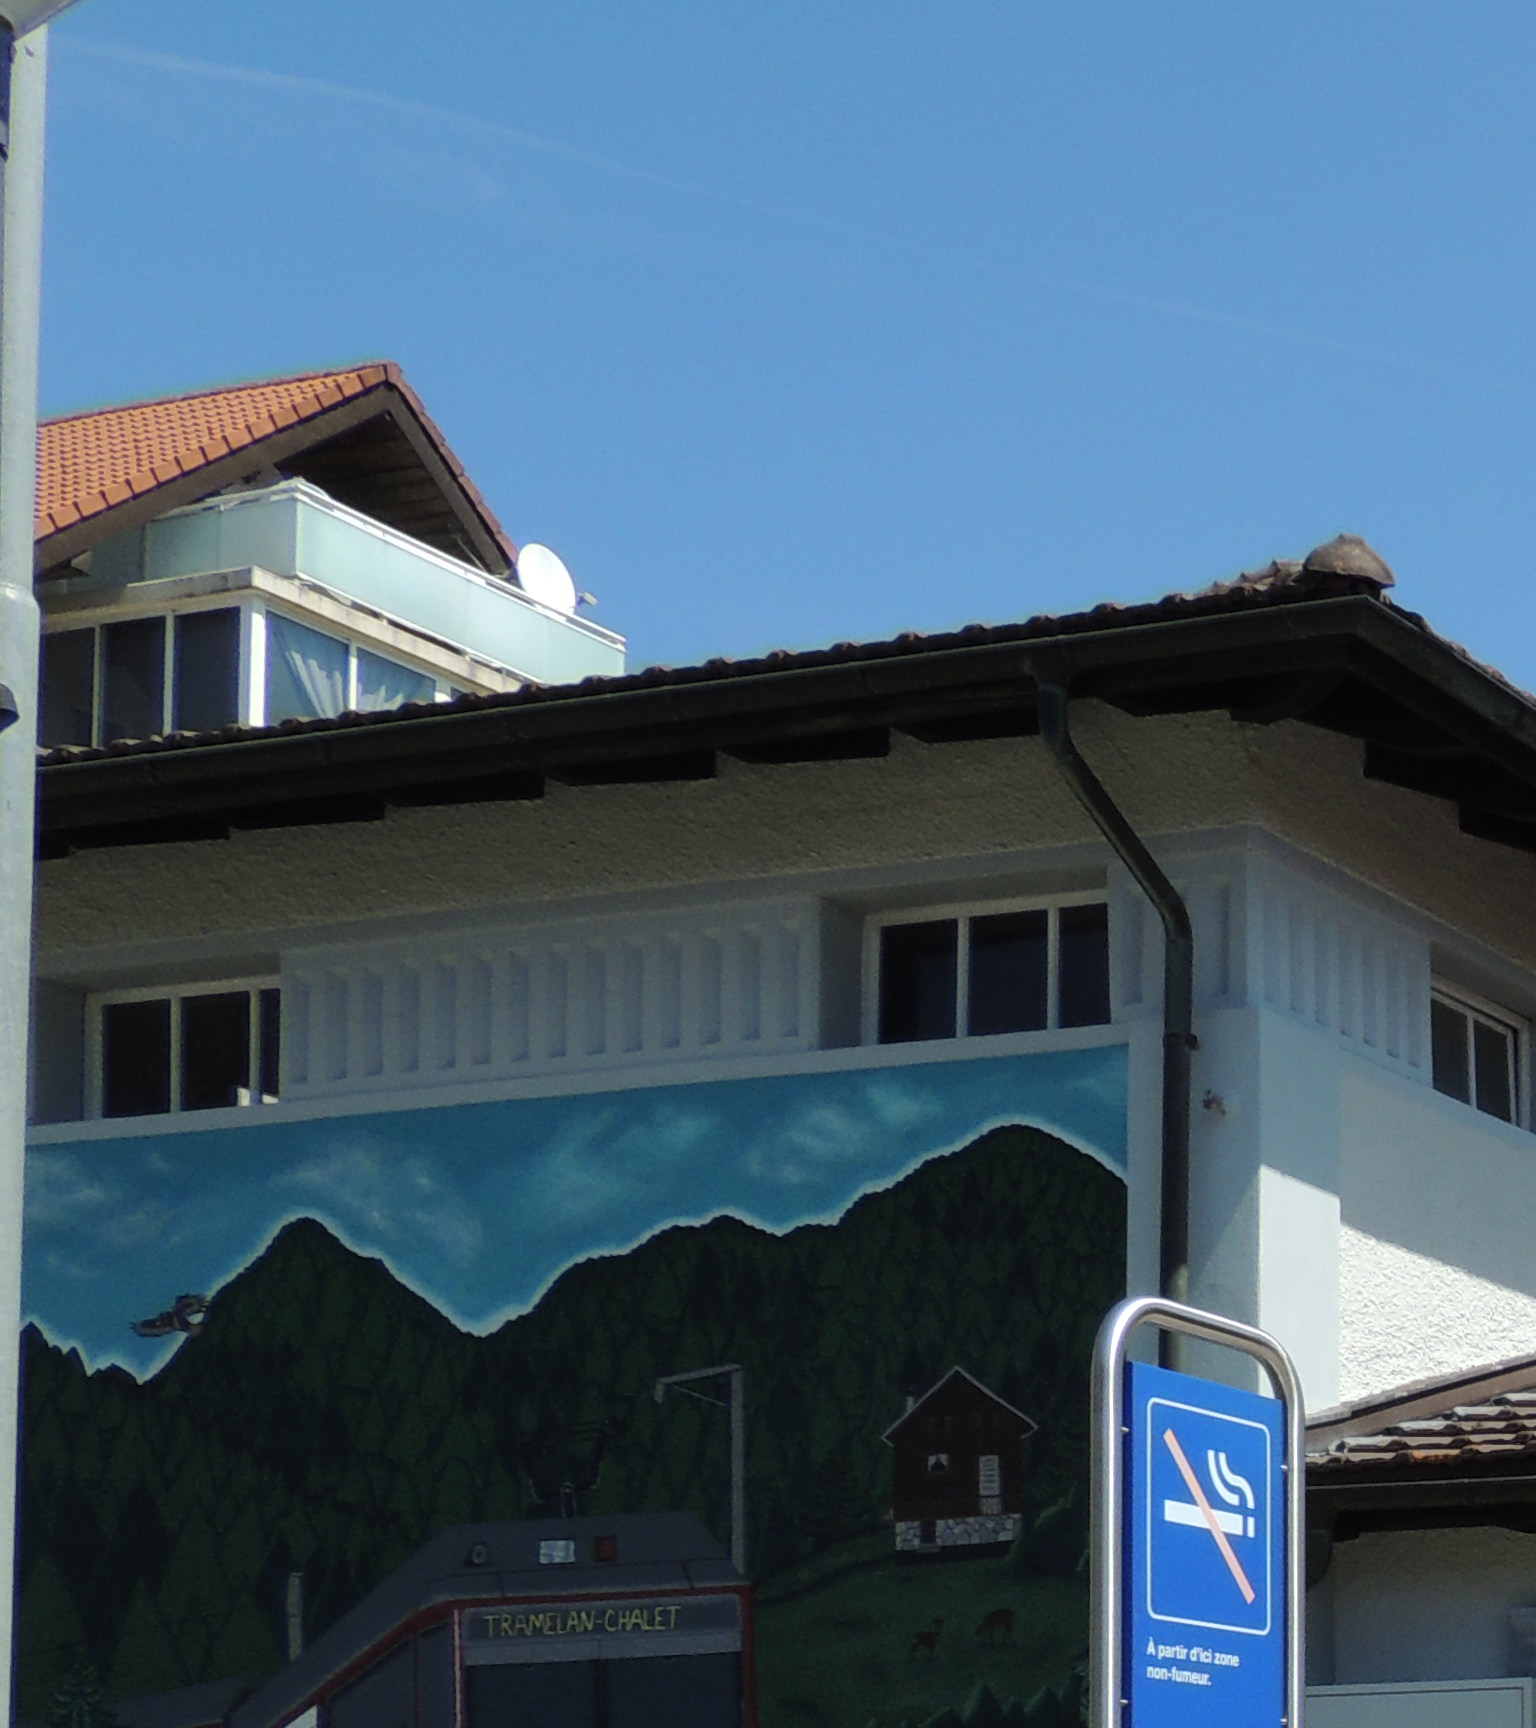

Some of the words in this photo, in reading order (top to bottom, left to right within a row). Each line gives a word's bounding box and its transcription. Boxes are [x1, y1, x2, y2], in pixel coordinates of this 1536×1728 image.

[484, 1606, 681, 1637] TRAMELAN-CHALET
[1146, 1636, 1155, 1656] À
[1157, 1644, 1188, 1660] partir
[1189, 1646, 1212, 1663] d'ici
[1214, 1652, 1240, 1667] zone
[1146, 1666, 1212, 1686] non-fumeur.
